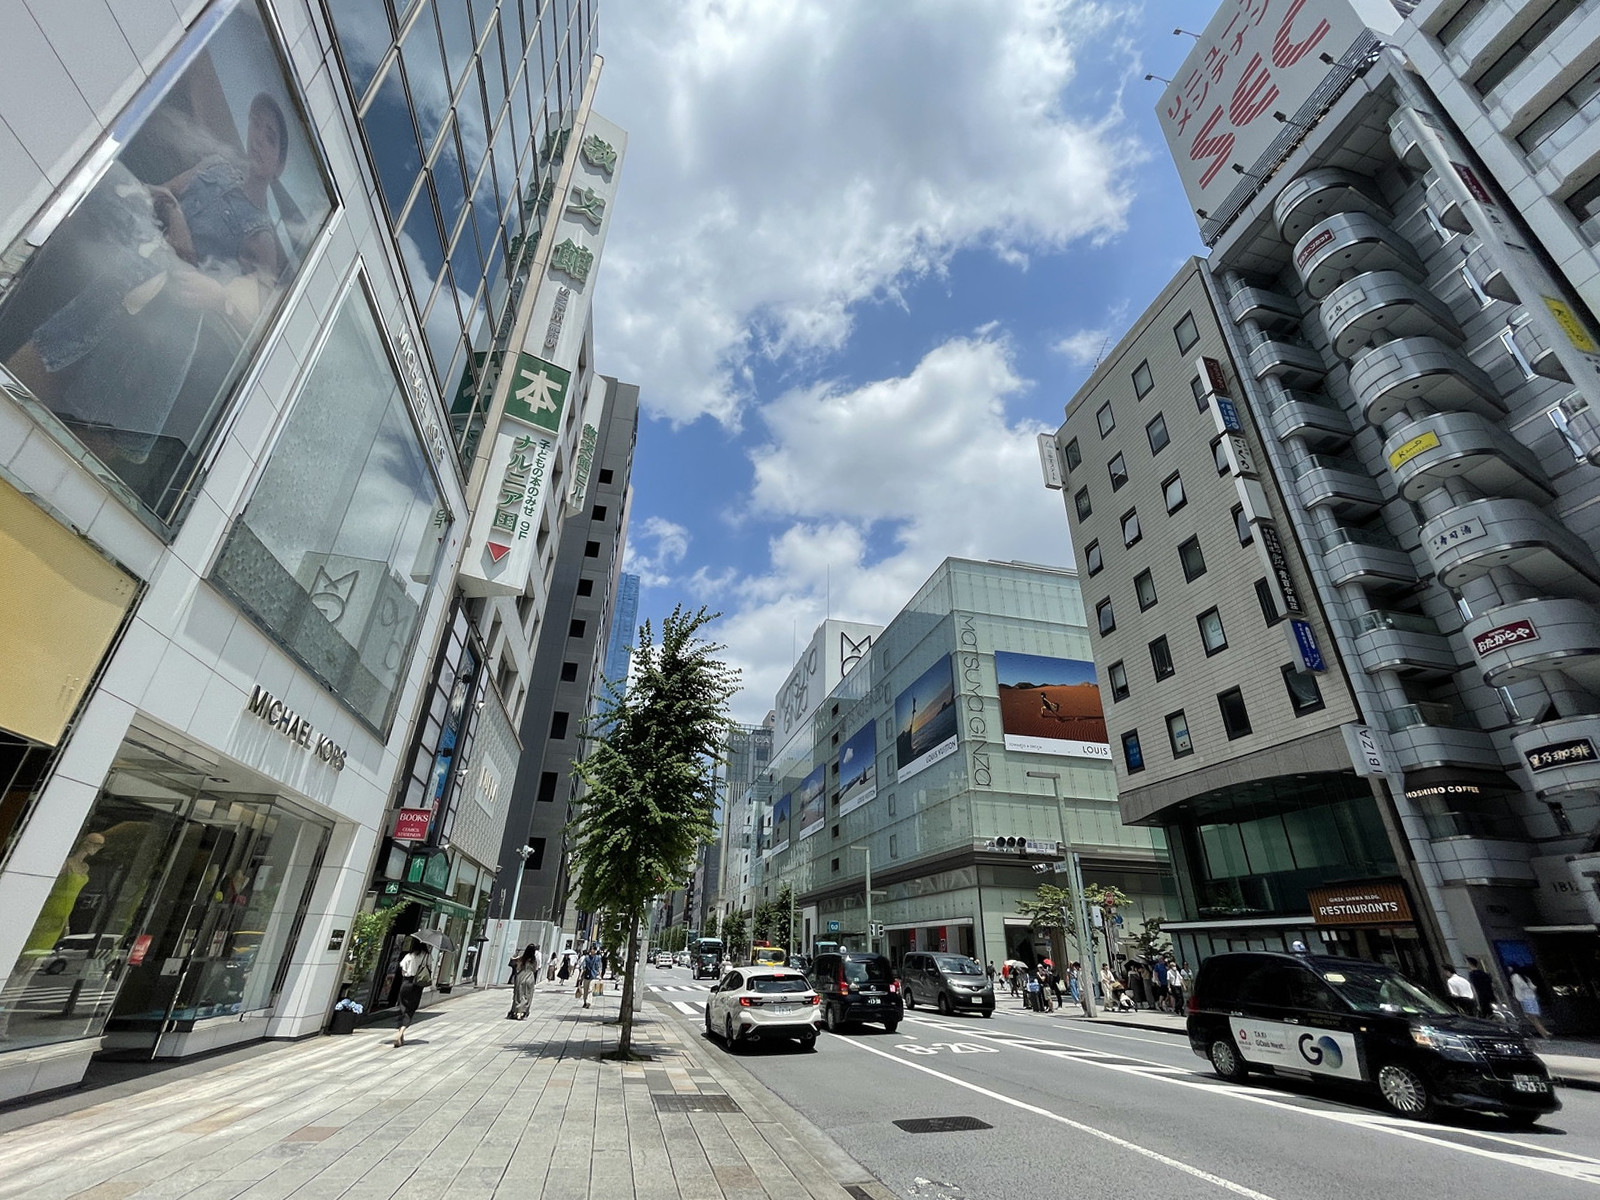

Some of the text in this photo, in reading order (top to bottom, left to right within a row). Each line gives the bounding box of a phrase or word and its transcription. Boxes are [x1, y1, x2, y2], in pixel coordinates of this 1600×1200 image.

[515, 369, 563, 414] 本
[493, 434, 537, 532] ナルニア国
[1477, 627, 1530, 653] おたからや
[248, 684, 348, 773] MICHAEL KORS
[1082, 745, 1108, 756] LOUIS
[1359, 729, 1383, 774] IBIZA
[1405, 785, 1480, 799] HOSHINO COFFEE
[399, 813, 429, 823] BOOKS
[1319, 902, 1398, 916] RESTAURANTS
